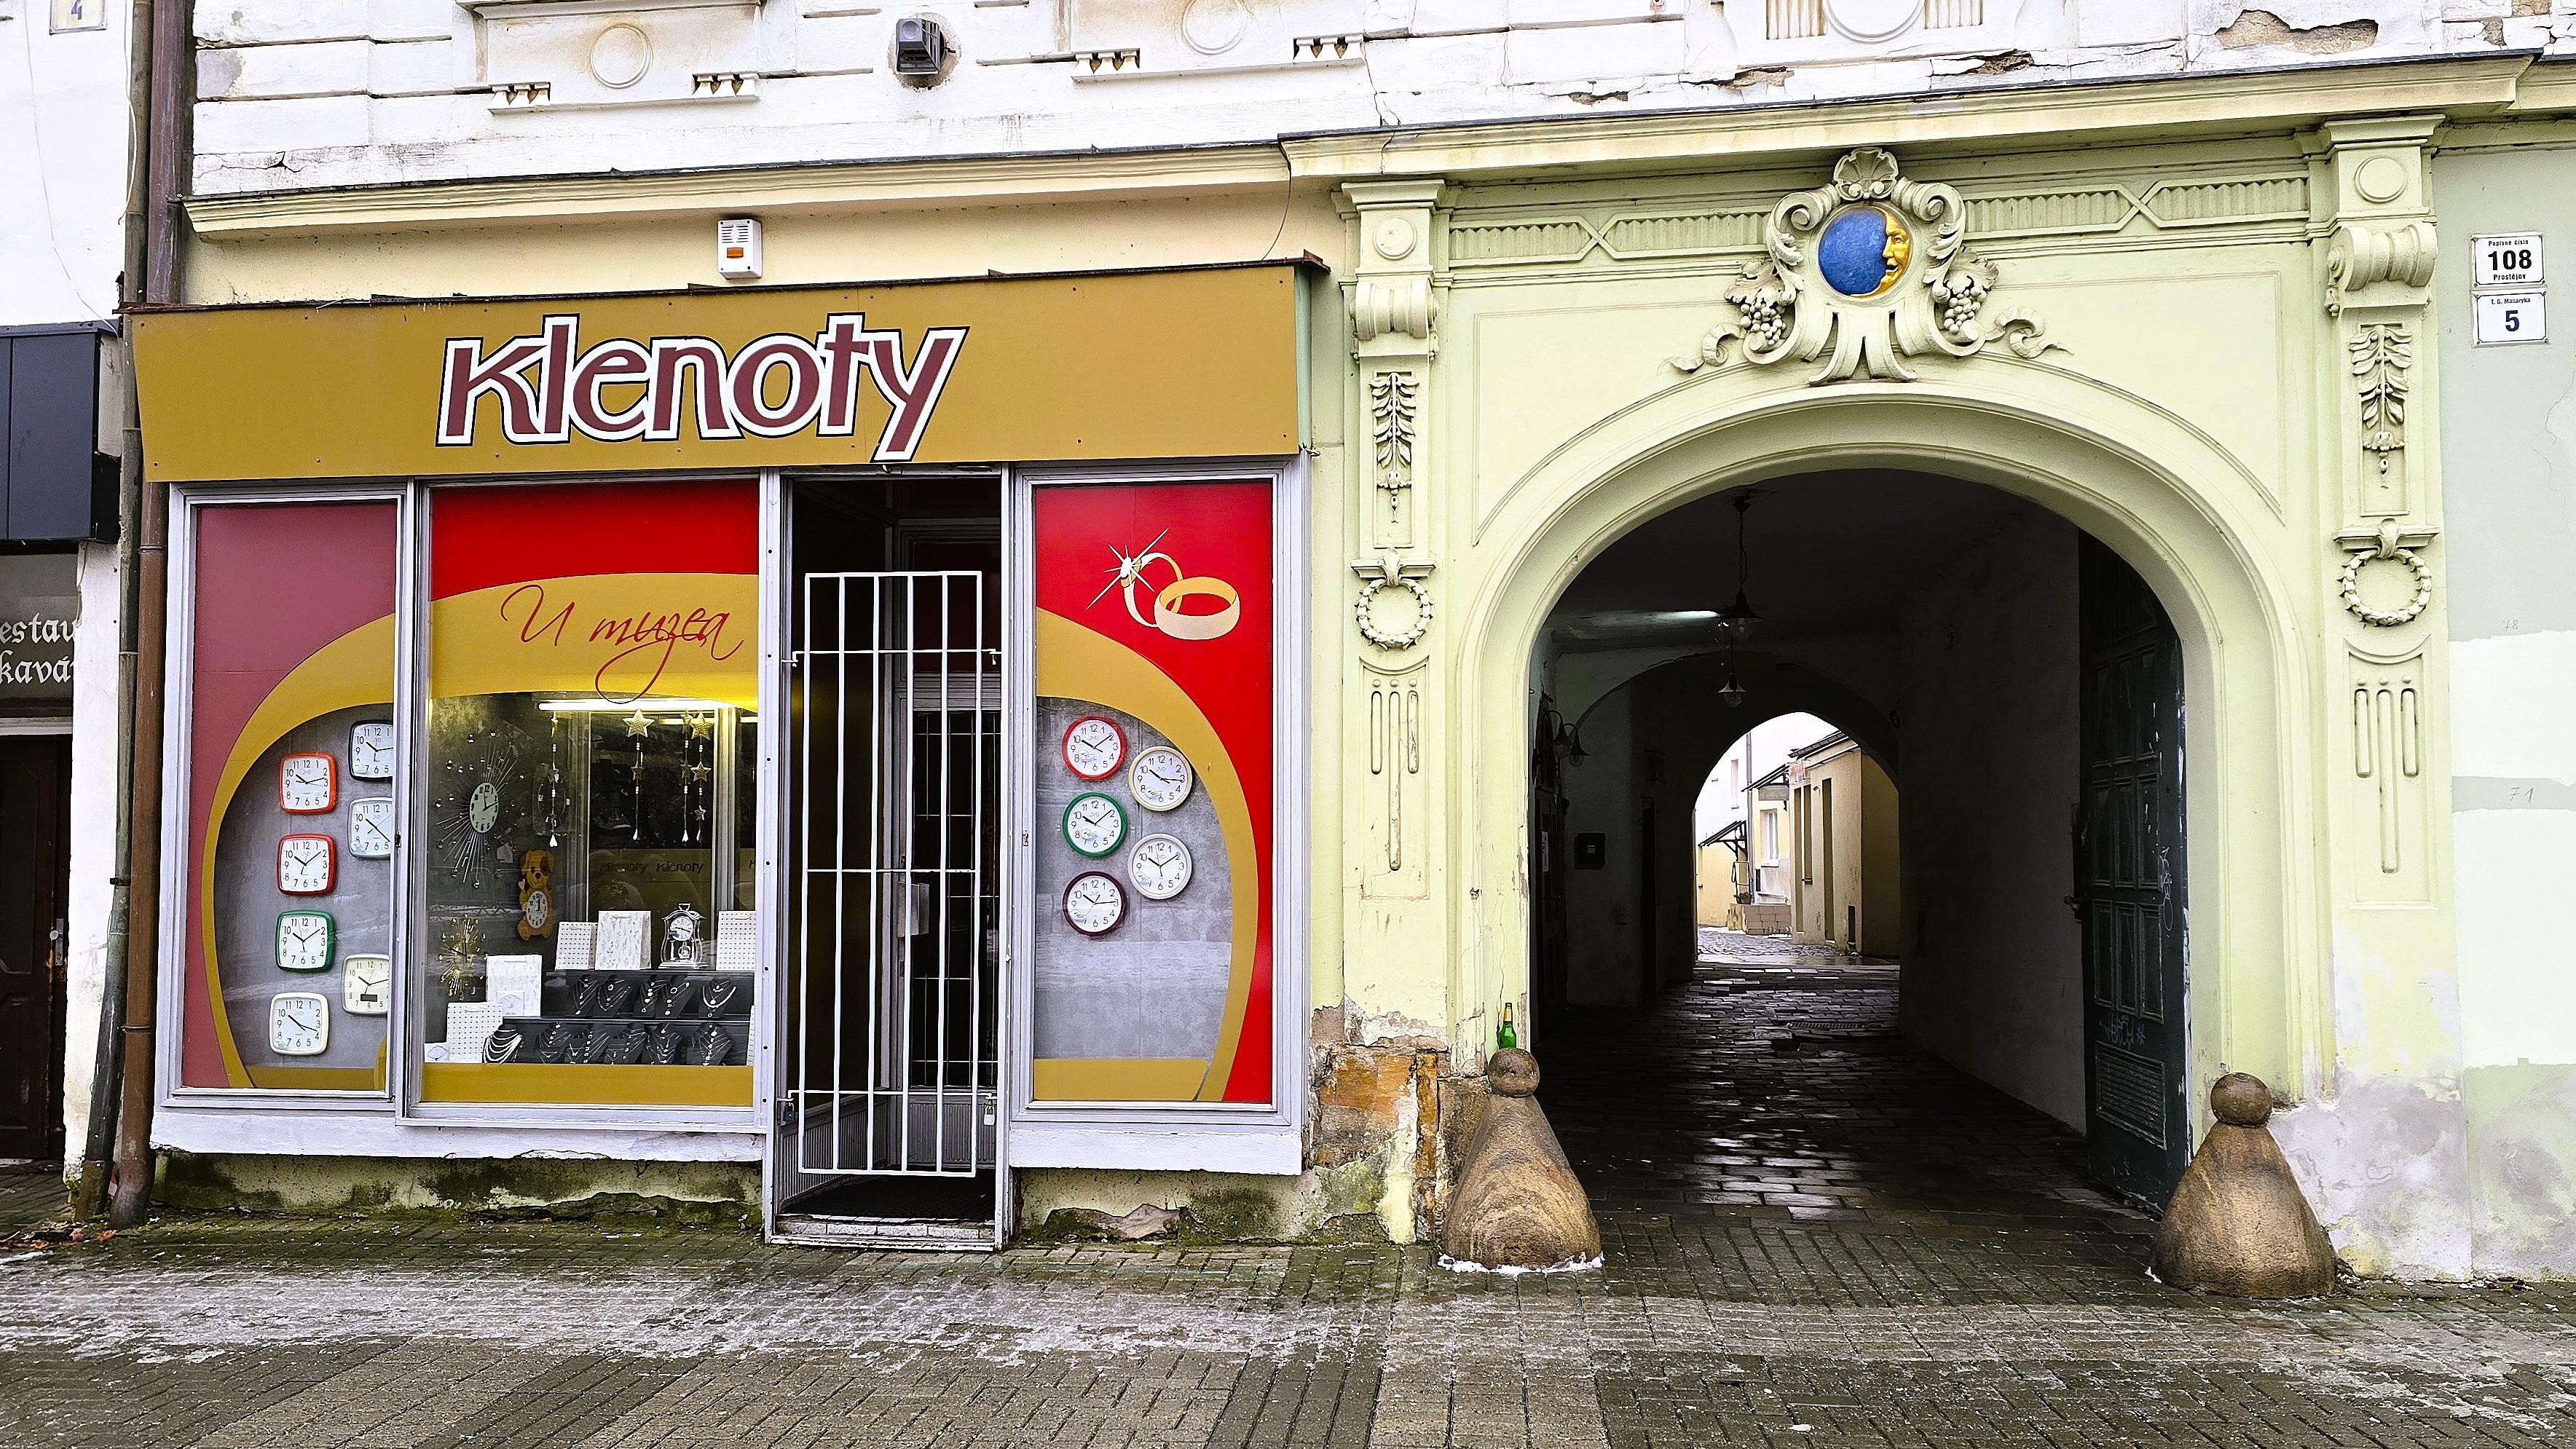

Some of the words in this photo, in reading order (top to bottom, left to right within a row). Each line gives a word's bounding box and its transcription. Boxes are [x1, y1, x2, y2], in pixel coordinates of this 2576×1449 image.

[71, 0, 82, 20] 4
[2488, 249, 2532, 271] 108
[2493, 273, 2526, 281] Prostějov
[2505, 309, 2520, 332] 5
[500, 584, 575, 647] U
[588, 607, 744, 705] muzea
[0, 650, 74, 684] kavá
[364, 728, 370, 736] 11
[374, 727, 381, 735] 12
[1081, 727, 1087, 735] 11
[1090, 724, 1098, 732] 12
[357, 736, 364, 744] 10
[1074, 735, 1081, 743] 10
[1108, 733, 1114, 741] 2
[355, 746, 360, 755] 9
[1113, 742, 1118, 751] 3
[1074, 754, 1079, 762] 8
[1148, 757, 1154, 765] 11
[1157, 755, 1165, 763] 12
[294, 760, 299, 769] 11
[304, 759, 310, 768] 12
[1092, 763, 1098, 771] 6
[1102, 760, 1108, 768] 5
[287, 768, 294, 777] 10
[323, 767, 328, 776] 2
[374, 765, 379, 773] 6
[385, 765, 389, 773] 5
[1140, 765, 1148, 773] 10
[1175, 765, 1182, 773] 2
[324, 778, 328, 786] 3
[1180, 774, 1185, 783] 3
[285, 779, 290, 788] 9
[1141, 784, 1146, 793] 8
[286, 791, 291, 799] 8
[1159, 793, 1164, 802] 6
[1169, 792, 1174, 800] 5
[295, 797, 300, 805] 7
[304, 797, 310, 805] 6
[1090, 800, 1098, 808] 12
[363, 805, 369, 813] 11
[373, 805, 380, 813] 12
[1082, 803, 1087, 811] 11
[355, 813, 363, 821] 10
[1074, 811, 1082, 820] 10
[1109, 809, 1115, 818] 2
[1071, 821, 1076, 829] 9
[1113, 819, 1119, 828] 3
[355, 824, 359, 832] 9
[1075, 830, 1080, 838] 8
[293, 842, 298, 850] 11
[303, 841, 310, 850] 12
[364, 842, 369, 850] 7
[374, 842, 379, 850] 6
[1147, 845, 1153, 853] 11
[1157, 842, 1165, 850] 12
[285, 850, 293, 858] 10
[322, 849, 327, 857] 2
[1139, 853, 1147, 861] 10
[1175, 852, 1181, 860] 2
[284, 861, 289, 869] 9
[323, 861, 328, 869] 3
[1178, 862, 1184, 871] 3
[285, 873, 289, 881] 8
[294, 879, 298, 887] 7
[303, 879, 307, 888] 6
[313, 879, 318, 887] 5
[1082, 883, 1087, 891] 11
[1090, 880, 1098, 888] 12
[1074, 891, 1082, 899] 10
[1109, 889, 1115, 897] 2
[1071, 900, 1076, 908] 9
[1113, 899, 1119, 907] 3
[302, 917, 309, 926] 12
[284, 926, 291, 934] 10
[321, 926, 326, 935] 2
[283, 936, 287, 945] 9
[320, 938, 326, 946] 3
[283, 949, 286, 957] 8
[291, 955, 296, 963] 7
[301, 956, 305, 964] 6
[311, 956, 315, 964] 5
[285, 1001, 291, 1009] 11
[296, 1000, 303, 1009] 12
[278, 1008, 285, 1017] 10
[315, 1008, 320, 1017] 2
[277, 1019, 282, 1028] 9
[316, 1020, 320, 1028] 3
[315, 1032, 320, 1040] 4
[287, 1038, 291, 1046] 7
[296, 1038, 301, 1047] 6
[306, 1038, 311, 1046] 5
